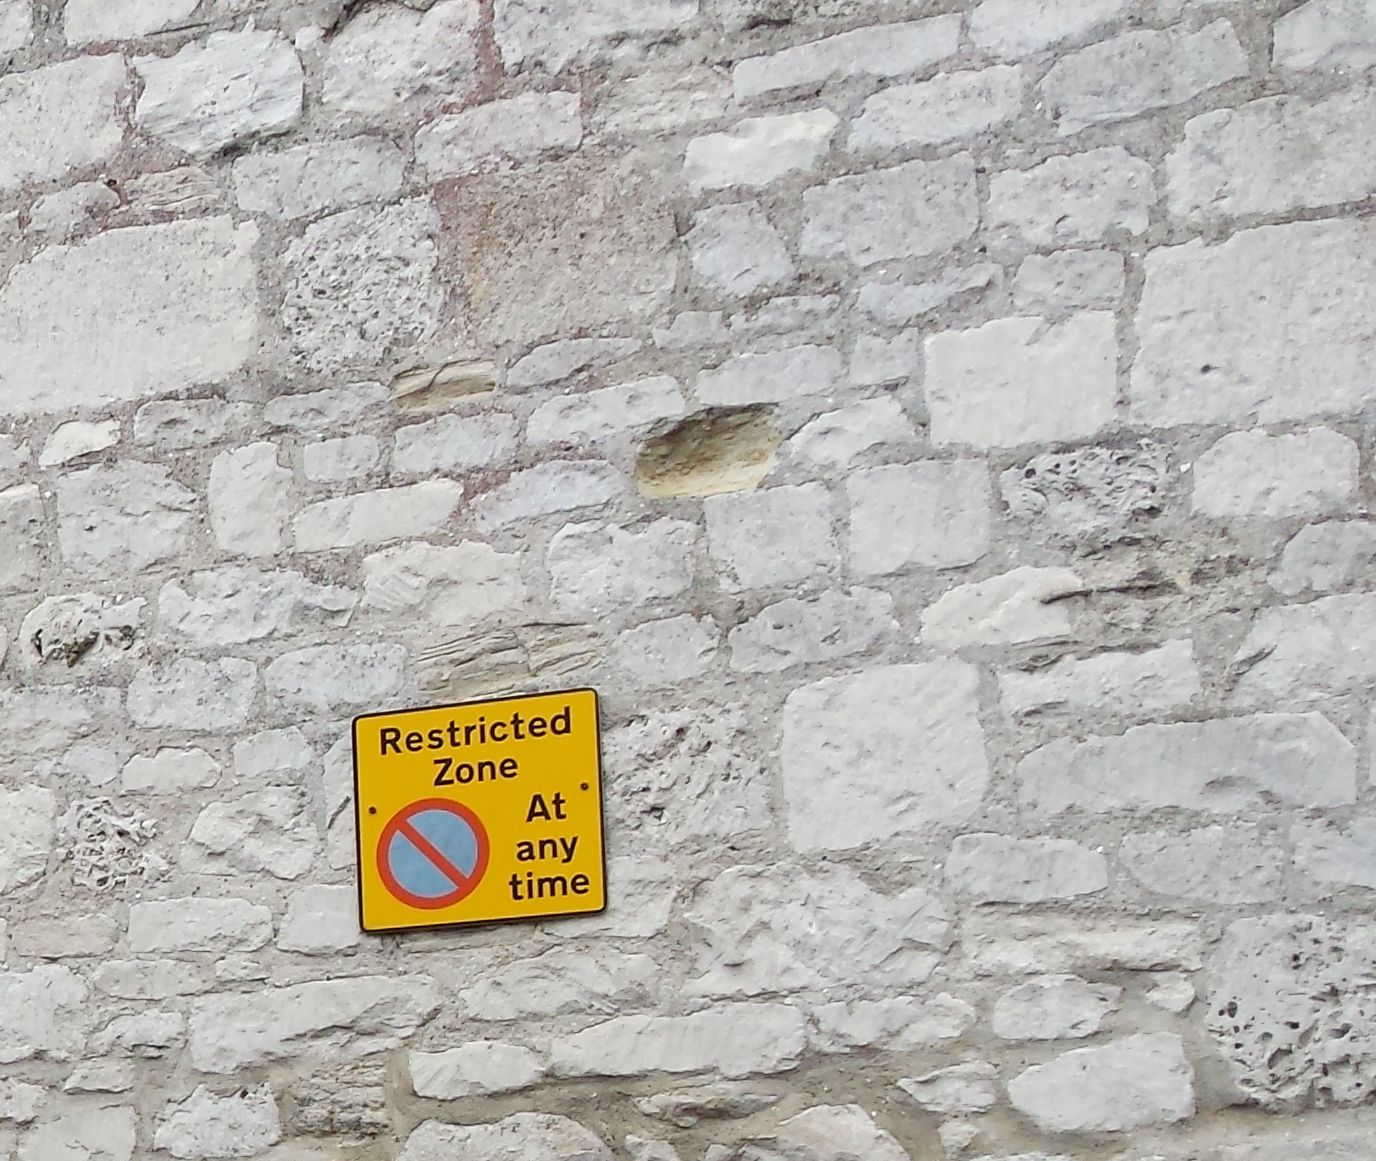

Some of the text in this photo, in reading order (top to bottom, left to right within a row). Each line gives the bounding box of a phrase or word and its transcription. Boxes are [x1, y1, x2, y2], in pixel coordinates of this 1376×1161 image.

[379, 705, 572, 756] Restricted
[432, 757, 519, 787] Zone
[525, 791, 568, 823] At
[515, 835, 579, 864] any
[508, 871, 590, 901] time
